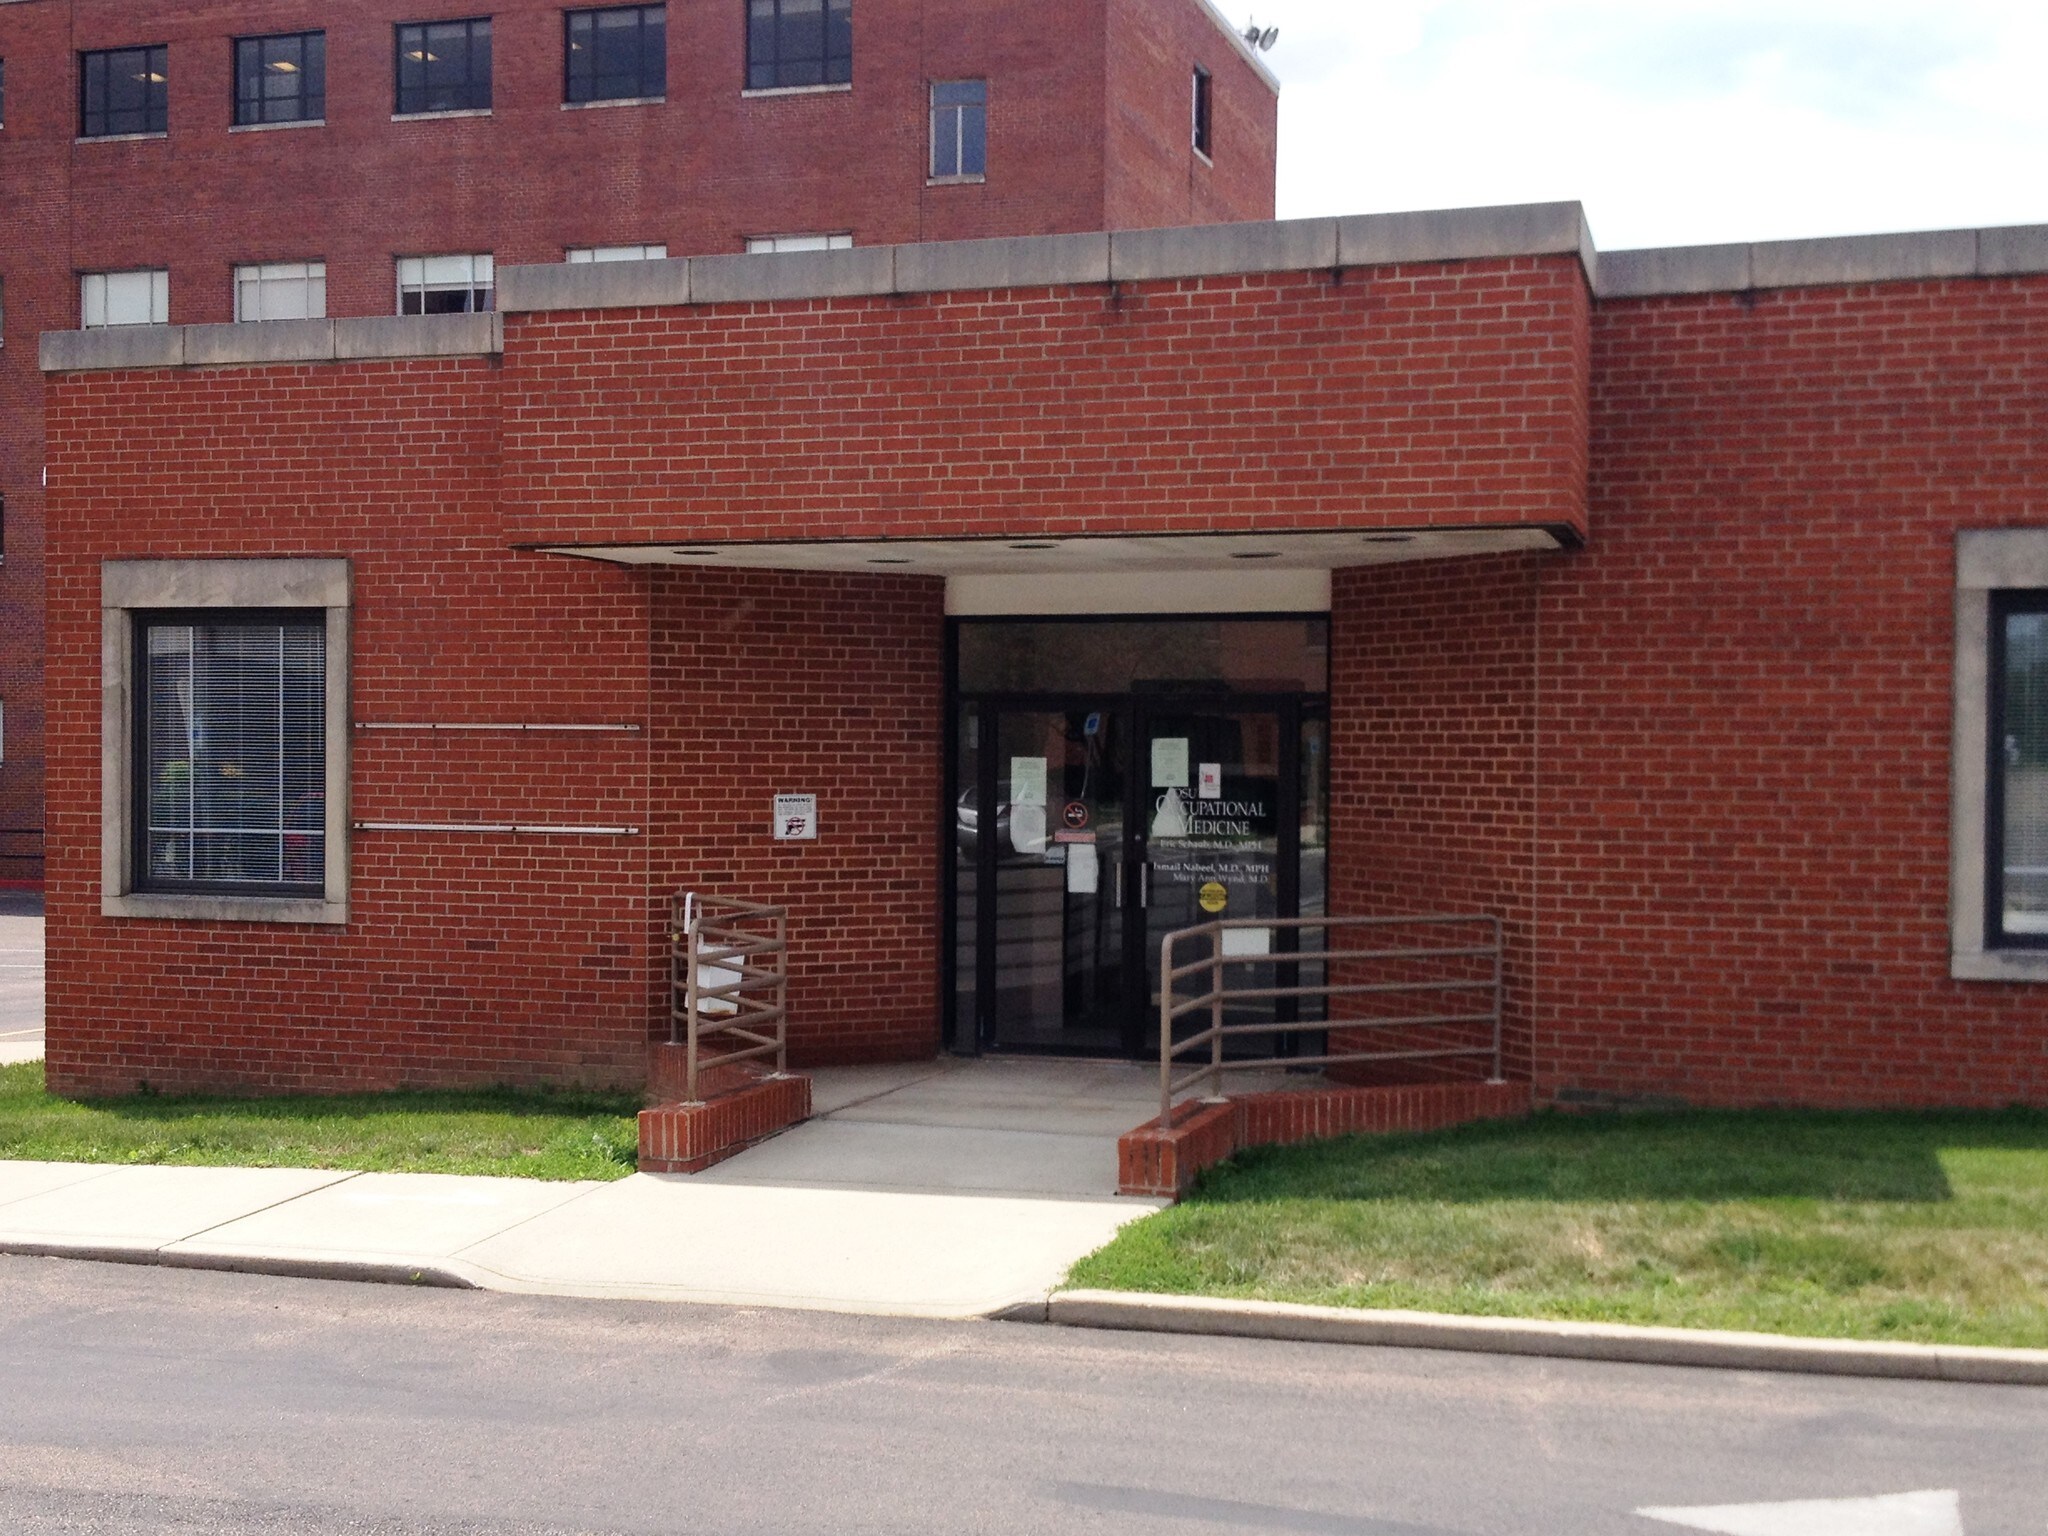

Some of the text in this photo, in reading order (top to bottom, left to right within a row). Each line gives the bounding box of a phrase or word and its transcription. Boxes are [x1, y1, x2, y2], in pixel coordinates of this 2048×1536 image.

[1155, 794, 1267, 817] OCUPATIONAL
[1177, 814, 1250, 836] MEDICINE
[1153, 861, 1180, 871] Ismail
[1245, 864, 1269, 873] MPH
